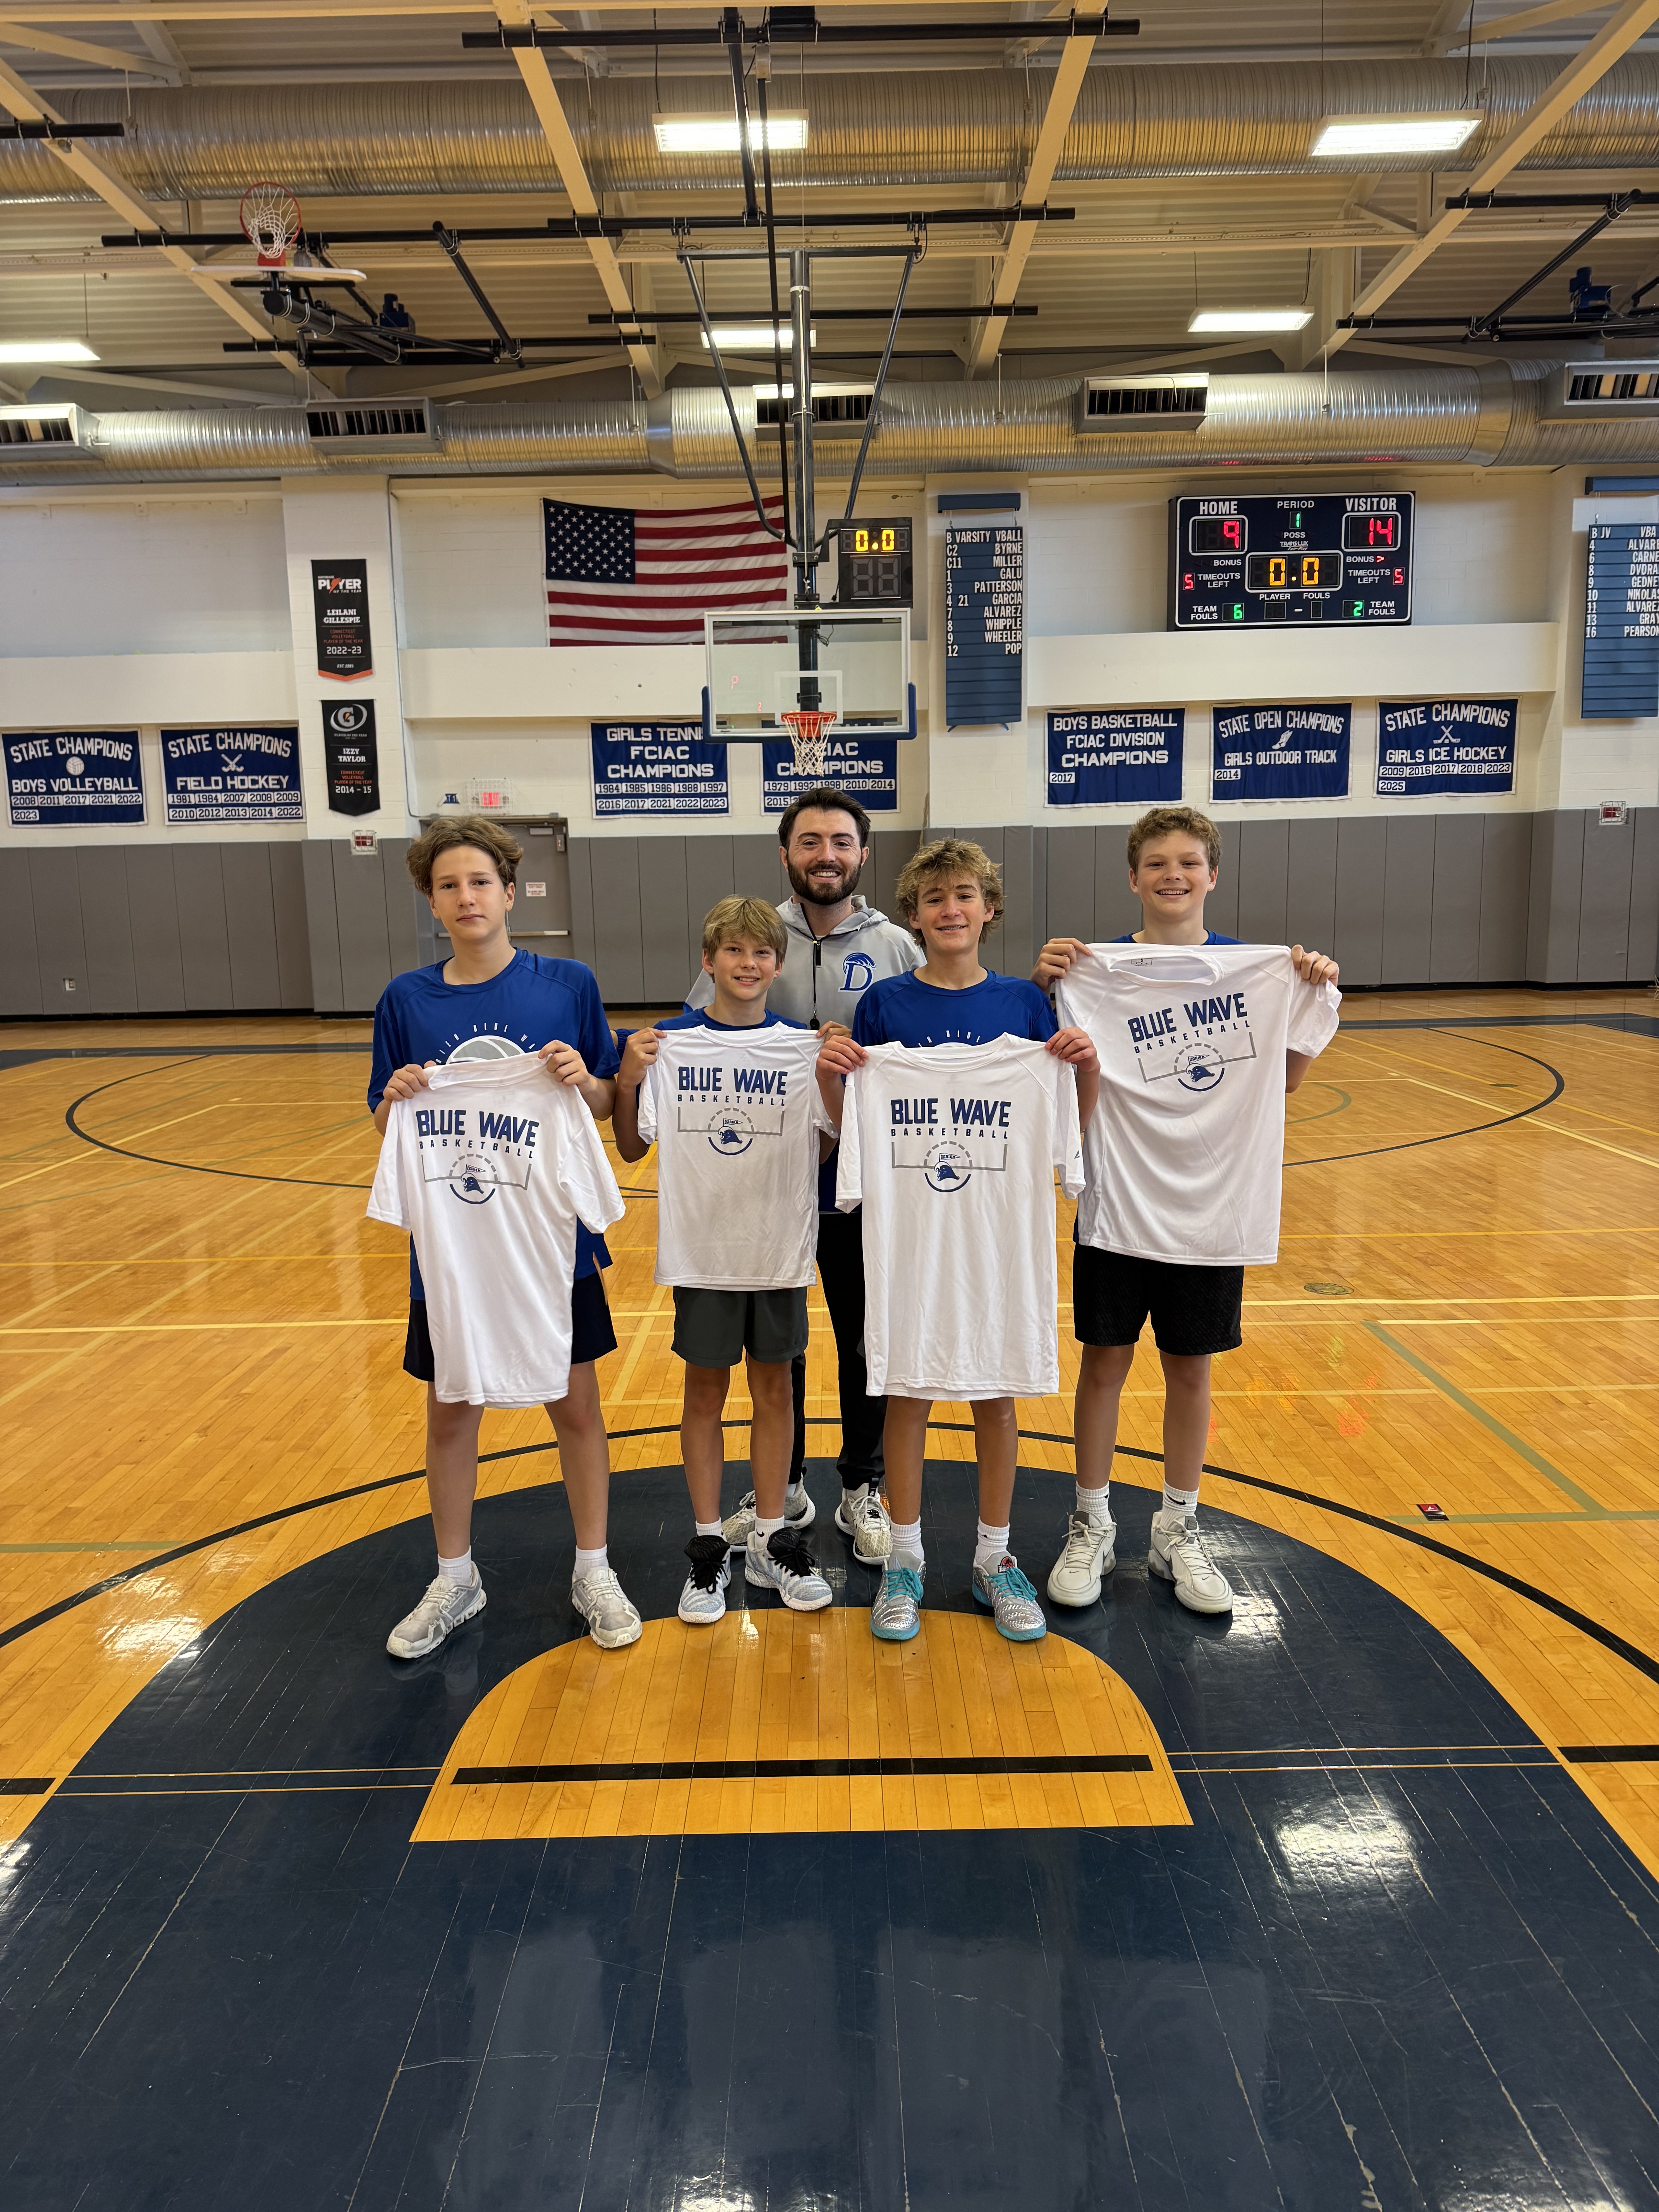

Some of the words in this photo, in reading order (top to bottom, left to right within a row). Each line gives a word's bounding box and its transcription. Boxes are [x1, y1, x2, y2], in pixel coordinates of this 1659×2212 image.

[1199, 501, 1238, 515] HOME
[1277, 500, 1314, 508] PERIOD
[1345, 497, 1396, 511] VISITOR
[1296, 513, 1300, 527] 1
[946, 532, 952, 543] B
[955, 531, 991, 543] VARSITY
[995, 530, 1022, 541] VBALL
[1224, 521, 1239, 548] 9
[1369, 518, 1393, 545] 14
[1592, 527, 1597, 539] B
[1601, 527, 1611, 538] JV
[947, 544, 958, 556] C2
[995, 543, 1022, 554] BYRNE
[1589, 539, 1595, 551] 4
[947, 557, 962, 568] C11
[993, 555, 1022, 567] MILLER
[1589, 552, 1595, 563] 6
[946, 570, 951, 581] 1
[1000, 567, 1022, 579] GALU
[1395, 569, 1403, 583] 5
[1589, 565, 1594, 576] 8
[947, 582, 952, 594] 3
[974, 580, 1022, 593] PATTERSON
[1185, 574, 1193, 589] 5
[1588, 577, 1594, 588] 9
[946, 595, 952, 606] 4
[958, 595, 969, 606] 21
[992, 593, 1022, 605] GARCIA
[1587, 589, 1598, 601] 10
[947, 608, 952, 619] 7
[984, 605, 1021, 618] ALVAREZ
[1233, 604, 1242, 619] 6
[1353, 601, 1363, 616] 2
[1587, 602, 1596, 613] 11
[947, 620, 953, 631] 8
[986, 618, 1022, 630] WHIPPLE
[1587, 614, 1597, 625] 13
[947, 633, 953, 644] 9
[984, 630, 1022, 642] WHEELER
[1586, 627, 1596, 637] 16
[948, 645, 958, 656] 12
[1005, 643, 1022, 654] POP
[1053, 716, 1087, 731] BOYS
[1091, 713, 1178, 729] BASKETBALL
[1385, 707, 1427, 731] STATE
[1432, 703, 1510, 728] CHAMPIONS
[1218, 714, 1250, 738] STATE
[1254, 711, 1281, 730] OPEN
[1286, 711, 1344, 734] CHAMPIONS
[606, 727, 652, 742] GIRLS
[1067, 734, 1105, 749] FCIAC
[1110, 732, 1164, 747] DIVISION
[10, 738, 52, 763] STATE
[56, 737, 132, 761] CHAMPIONS
[168, 734, 212, 758] STATE
[216, 732, 292, 757] CHAMPIONS
[630, 746, 689, 759] FCIAC
[1062, 750, 1168, 768] CHAMPIONS
[1224, 752, 1252, 766] GIRLS
[1256, 750, 1301, 765] OUTDOOR
[1305, 750, 1337, 763] TRACK
[1386, 749, 1424, 763] GIRLS
[1429, 747, 1450, 761] ICE
[1454, 746, 1507, 761] HOCKEY
[607, 764, 714, 778] CHAMPIONS
[777, 761, 883, 776] CHMPIONS
[1216, 770, 1239, 779] 2014
[1381, 767, 1404, 776] 2009
[1408, 766, 1431, 775] 2016
[1435, 764, 1456, 773] 2017
[1461, 764, 1482, 773] 2018
[1487, 764, 1510, 772] 2023
[12, 779, 46, 793] BOYS
[50, 777, 138, 792] VOLLEYBALL
[177, 776, 222, 790] FIELD
[227, 775, 289, 789] HOCKEY
[1051, 774, 1073, 782] 2017
[598, 785, 620, 793] 1984
[625, 784, 646, 792] 1985
[651, 784, 672, 792] 1986
[767, 782, 788, 791] 1979
[845, 780, 867, 789] 2010
[871, 780, 893, 789] 2014
[1381, 782, 1404, 790] 2025
[13, 797, 35, 805] 2008
[40, 797, 60, 805] 2011
[65, 795, 87, 804] 2017
[91, 795, 113, 804] 2021
[117, 794, 141, 804] 2022
[171, 795, 191, 803] 1981
[198, 794, 218, 803] 1984
[250, 793, 272, 802] 2008
[276, 793, 299, 801] 2009
[624, 800, 646, 808] 2017
[650, 799, 672, 808] 2021
[676, 799, 697, 807] 2022
[703, 799, 725, 807] 2023
[767, 798, 788, 806] 2015
[14, 811, 37, 819] 2023
[172, 810, 194, 818] 2010
[225, 808, 247, 817] 2013
[251, 808, 273, 816] 2014
[277, 807, 300, 816] 2022
[839, 960, 873, 991] D
[1128, 1008, 1177, 1043] BLUE
[1183, 992, 1247, 1027] WAVE
[473, 1022, 508, 1032] BLUE
[1134, 1020, 1250, 1053] BASKETBALL
[678, 1066, 722, 1091] BLUE
[733, 1068, 788, 1095] WAVE
[678, 1094, 785, 1106] BASKETBALL
[891, 1098, 938, 1125] BLUE
[950, 1098, 1011, 1127] WAVE
[416, 1109, 466, 1137] BLUE
[479, 1111, 539, 1147] WAVE
[891, 1128, 1008, 1139] BASKETBALL
[419, 1139, 532, 1159] BASKETBALL
